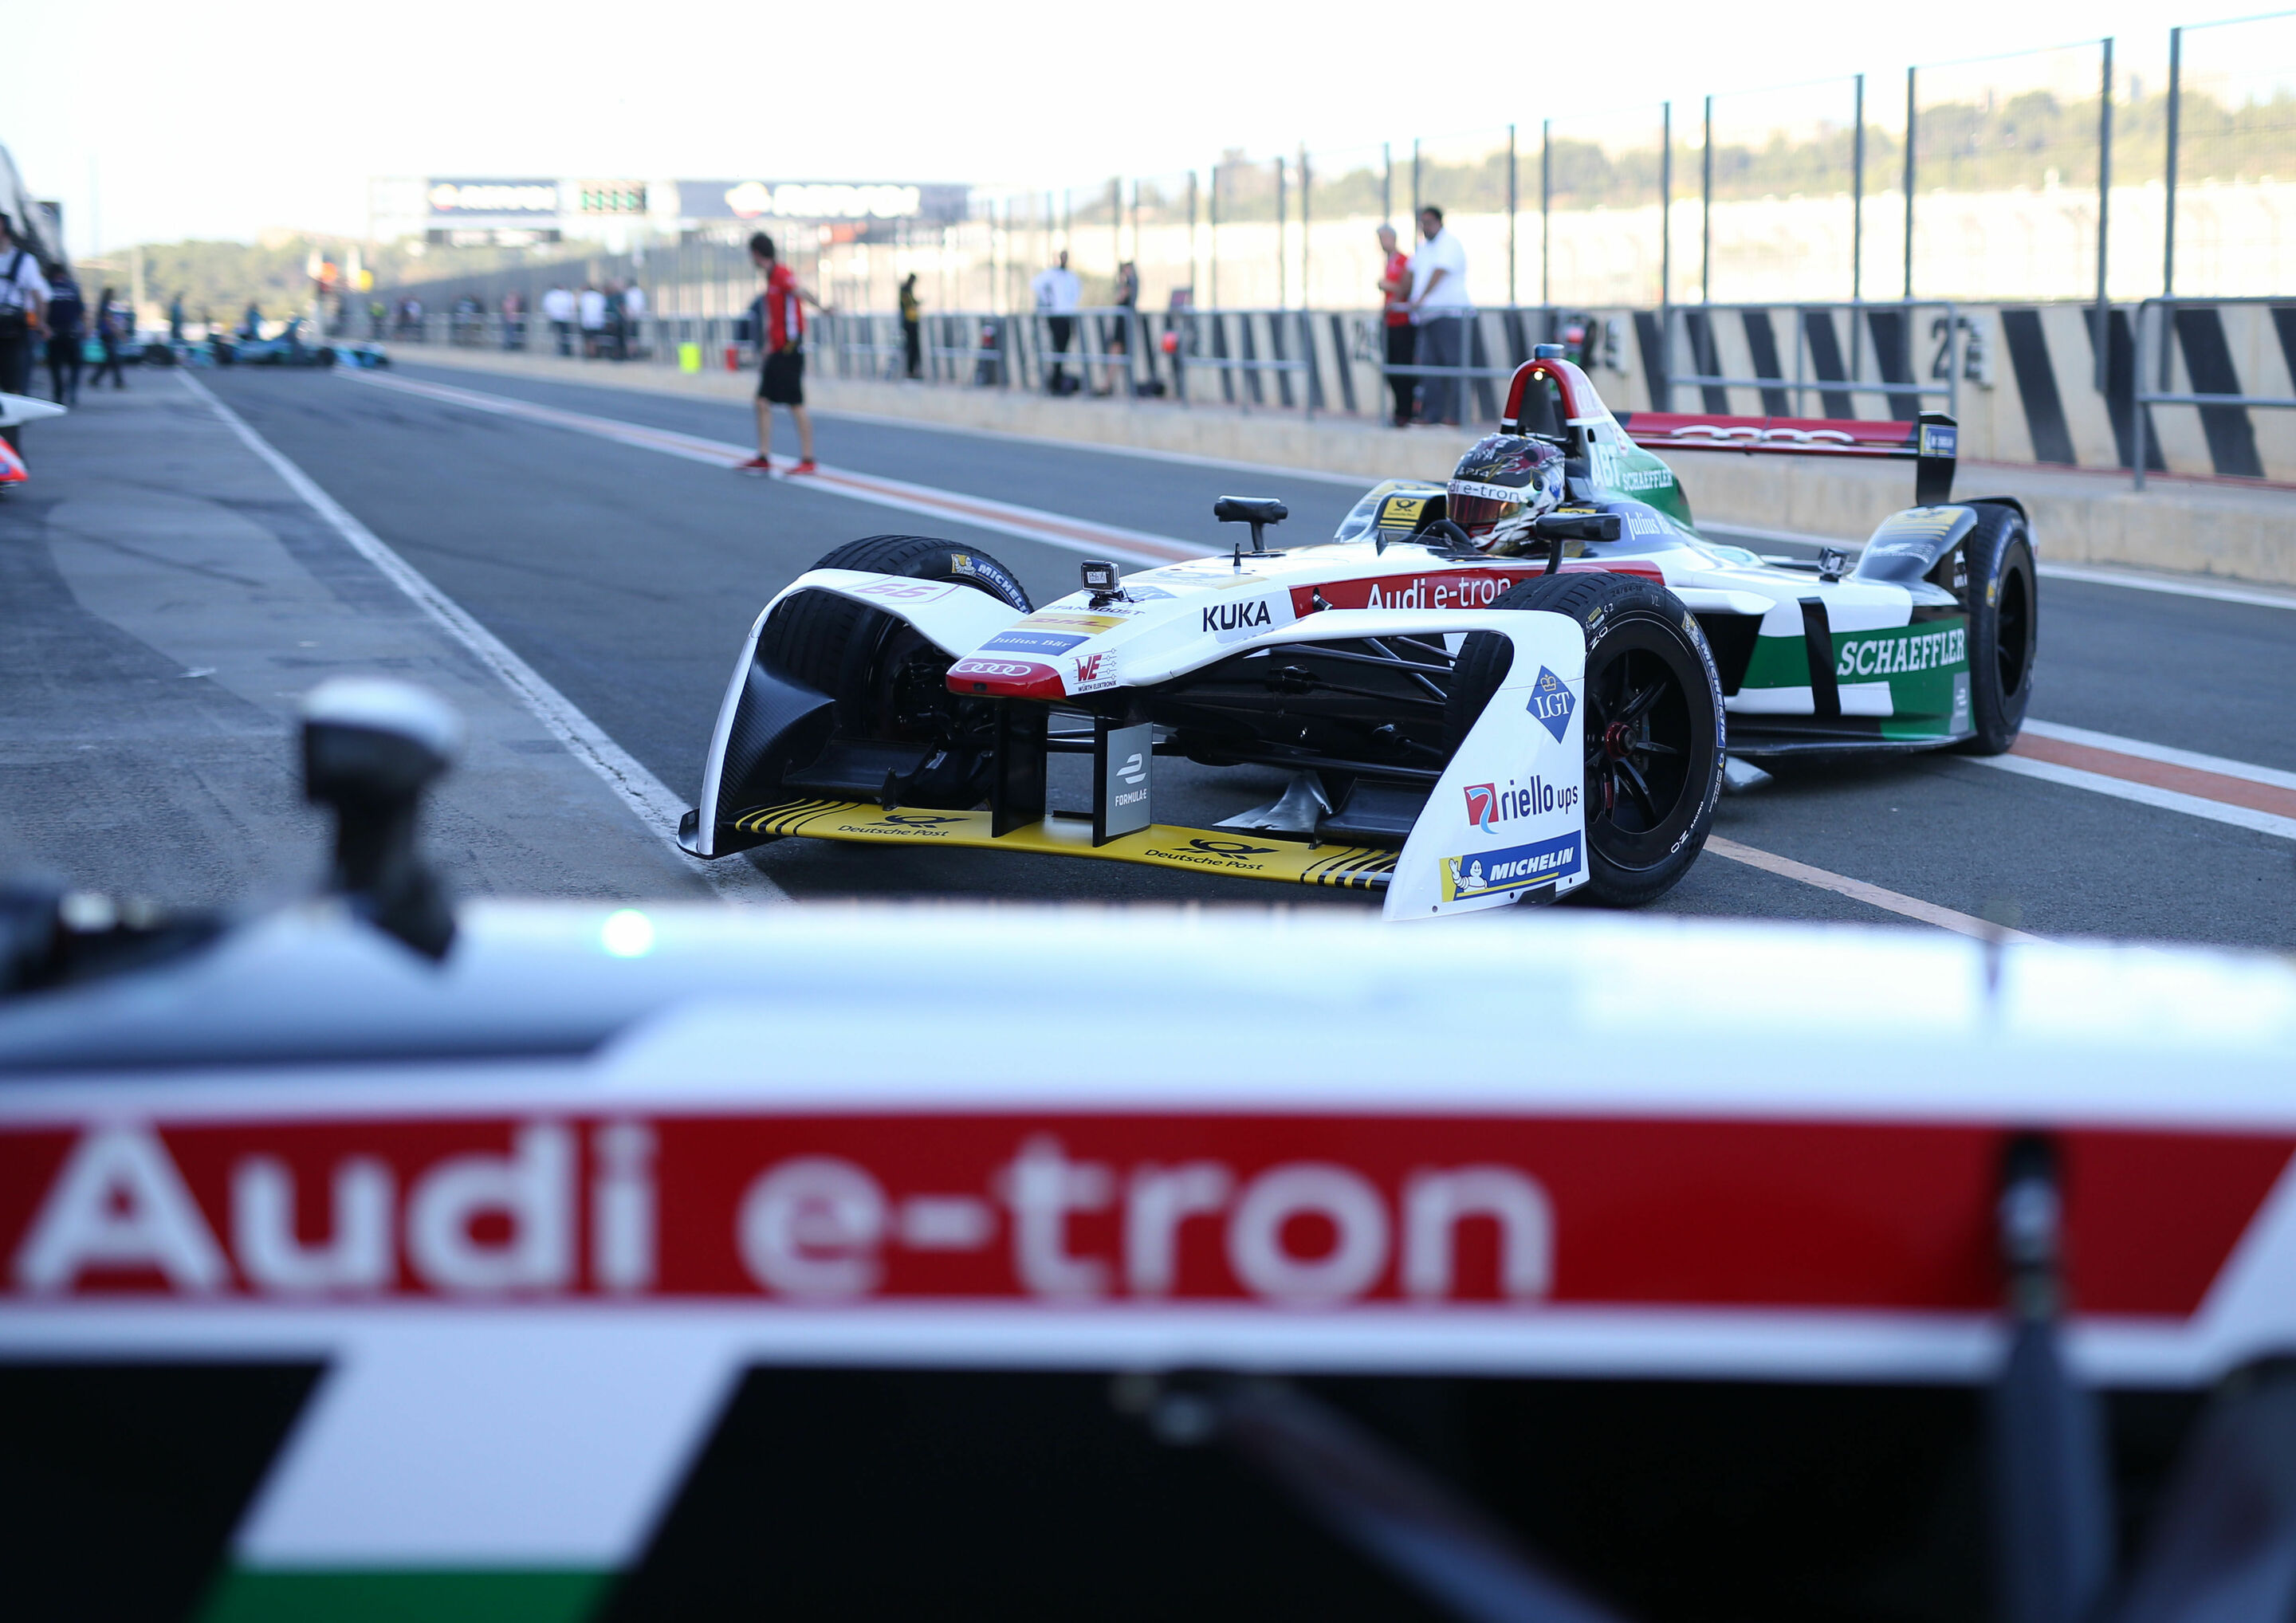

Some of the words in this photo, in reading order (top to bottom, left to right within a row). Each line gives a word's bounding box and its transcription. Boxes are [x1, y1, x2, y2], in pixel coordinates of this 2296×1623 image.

[1464, 484, 1520, 502] e-tron
[1622, 469, 1673, 491] SCHAEFFLER
[1625, 512, 1661, 541] Julius
[1366, 578, 1426, 609] Audi
[1434, 576, 1512, 609] e-tron
[1203, 600, 1272, 632] KUKA
[992, 637, 1038, 646] Julius
[1040, 638, 1071, 647] Bär
[1836, 628, 1965, 676] SCHAEFFLER
[1534, 691, 1571, 719] LGT
[1700, 643, 1726, 745] MICHELIN
[1501, 774, 1553, 821] riello
[1557, 785, 1578, 815] ups
[838, 825, 911, 835] Deutsche
[1144, 849, 1223, 866] Deutsche
[1225, 860, 1264, 870] Post
[1489, 847, 1575, 882] MICHELIN
[11, 1116, 660, 1296] Audi
[732, 1130, 1556, 1306] e-tron
